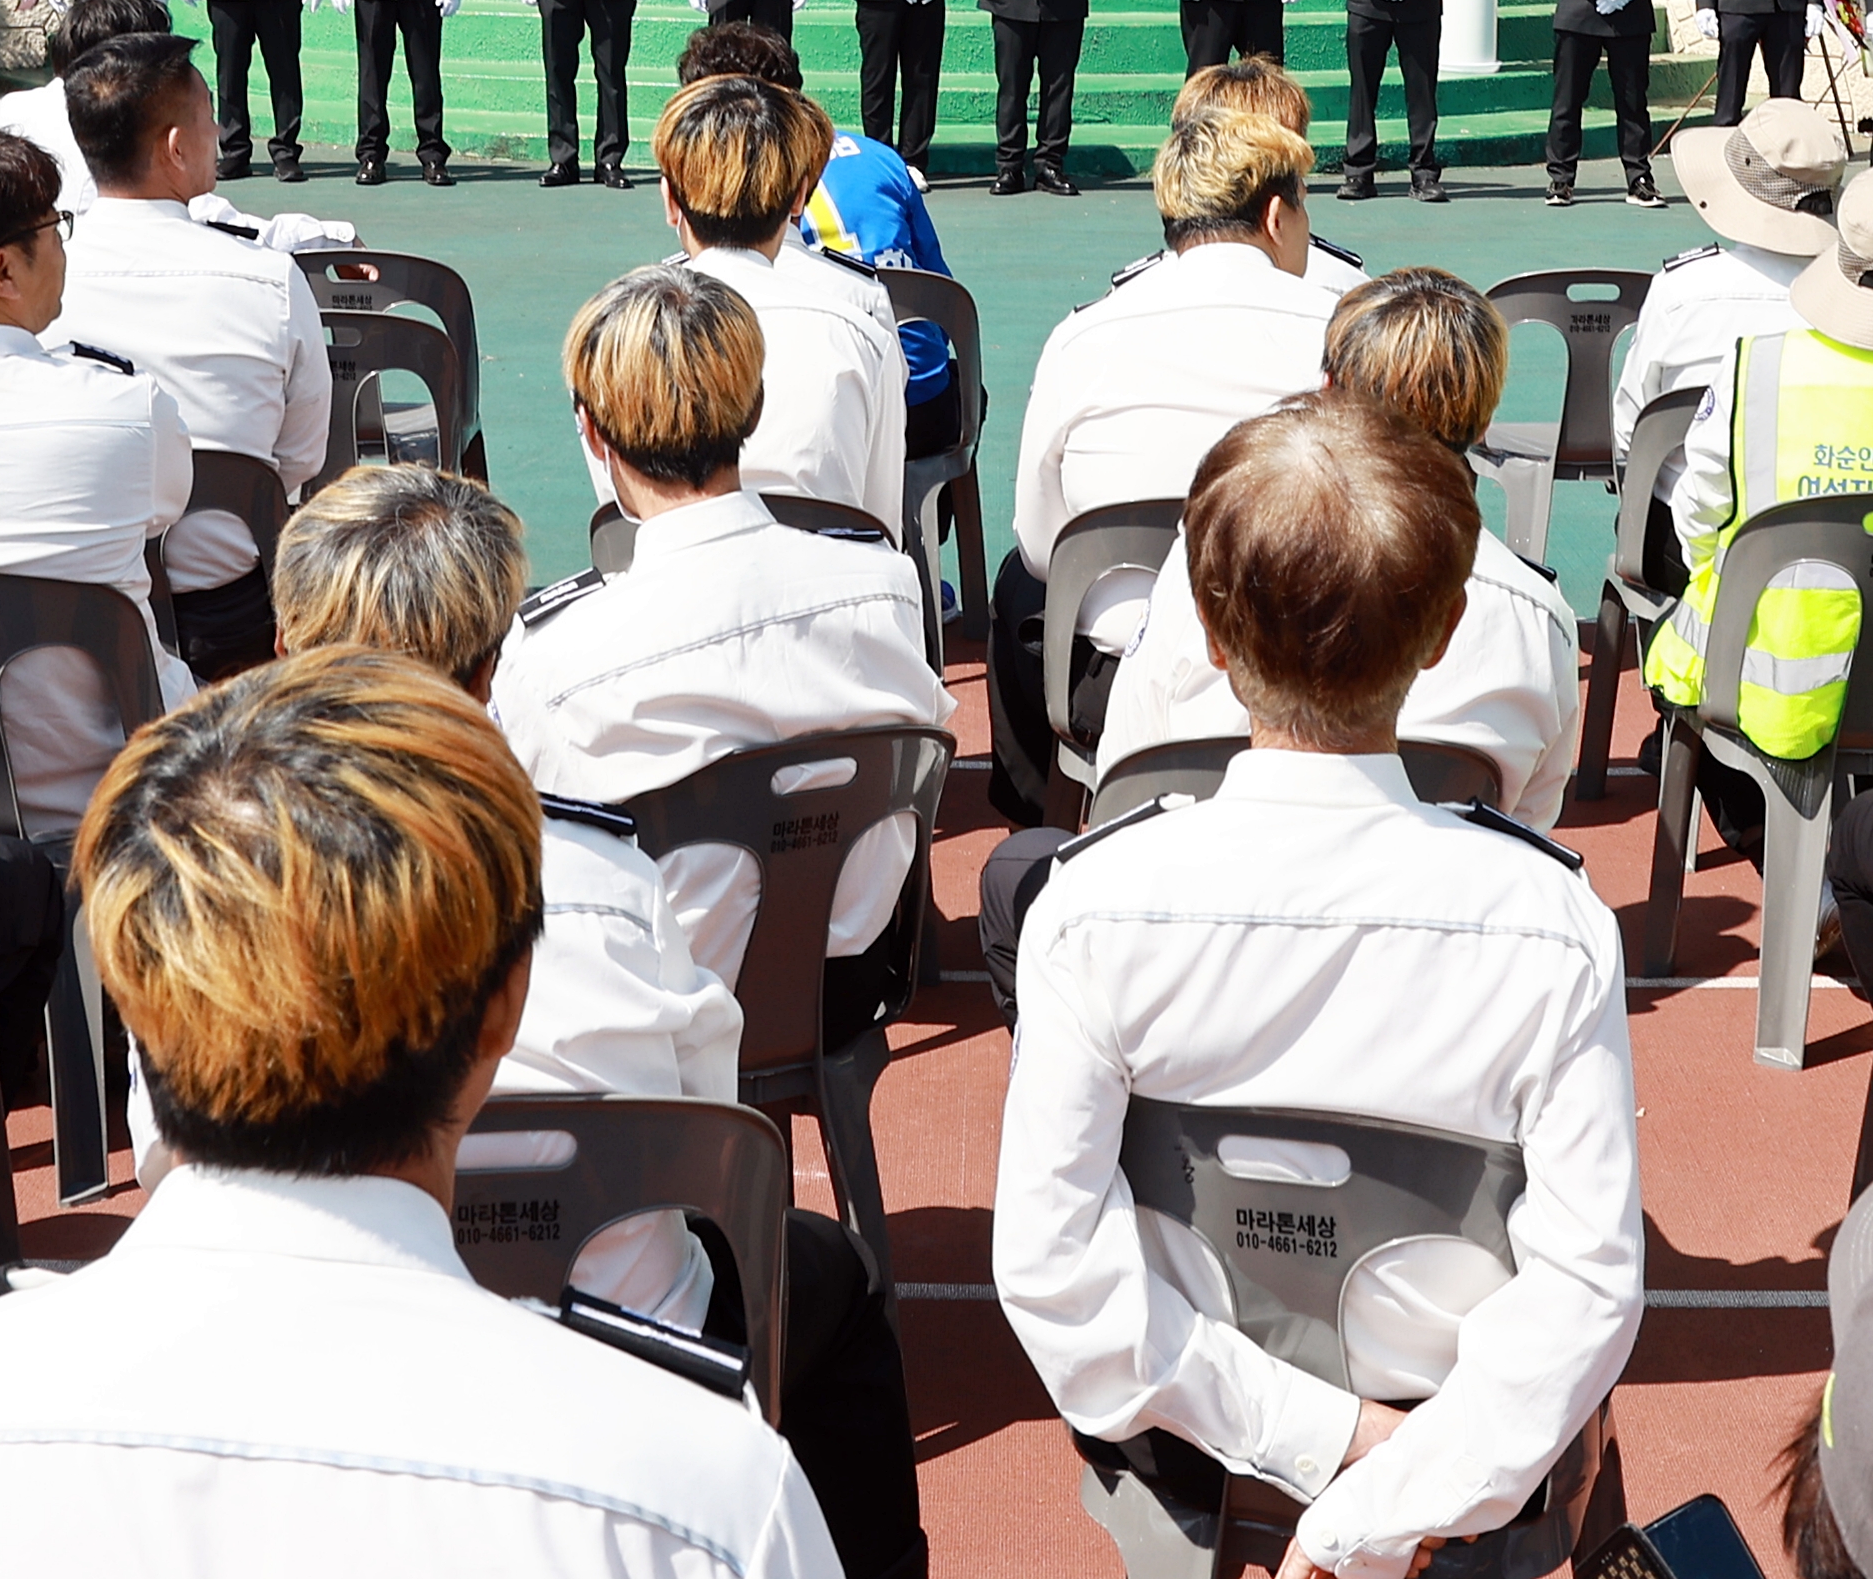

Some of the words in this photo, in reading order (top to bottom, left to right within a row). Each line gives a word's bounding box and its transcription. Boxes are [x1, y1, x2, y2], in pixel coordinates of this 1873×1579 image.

[772, 811, 840, 838] 마라톤세상
[458, 1223, 561, 1244] 010-4661-6212
[1236, 1209, 1337, 1239] 마라톤세상
[1236, 1232, 1338, 1258] 010-4661-6212
